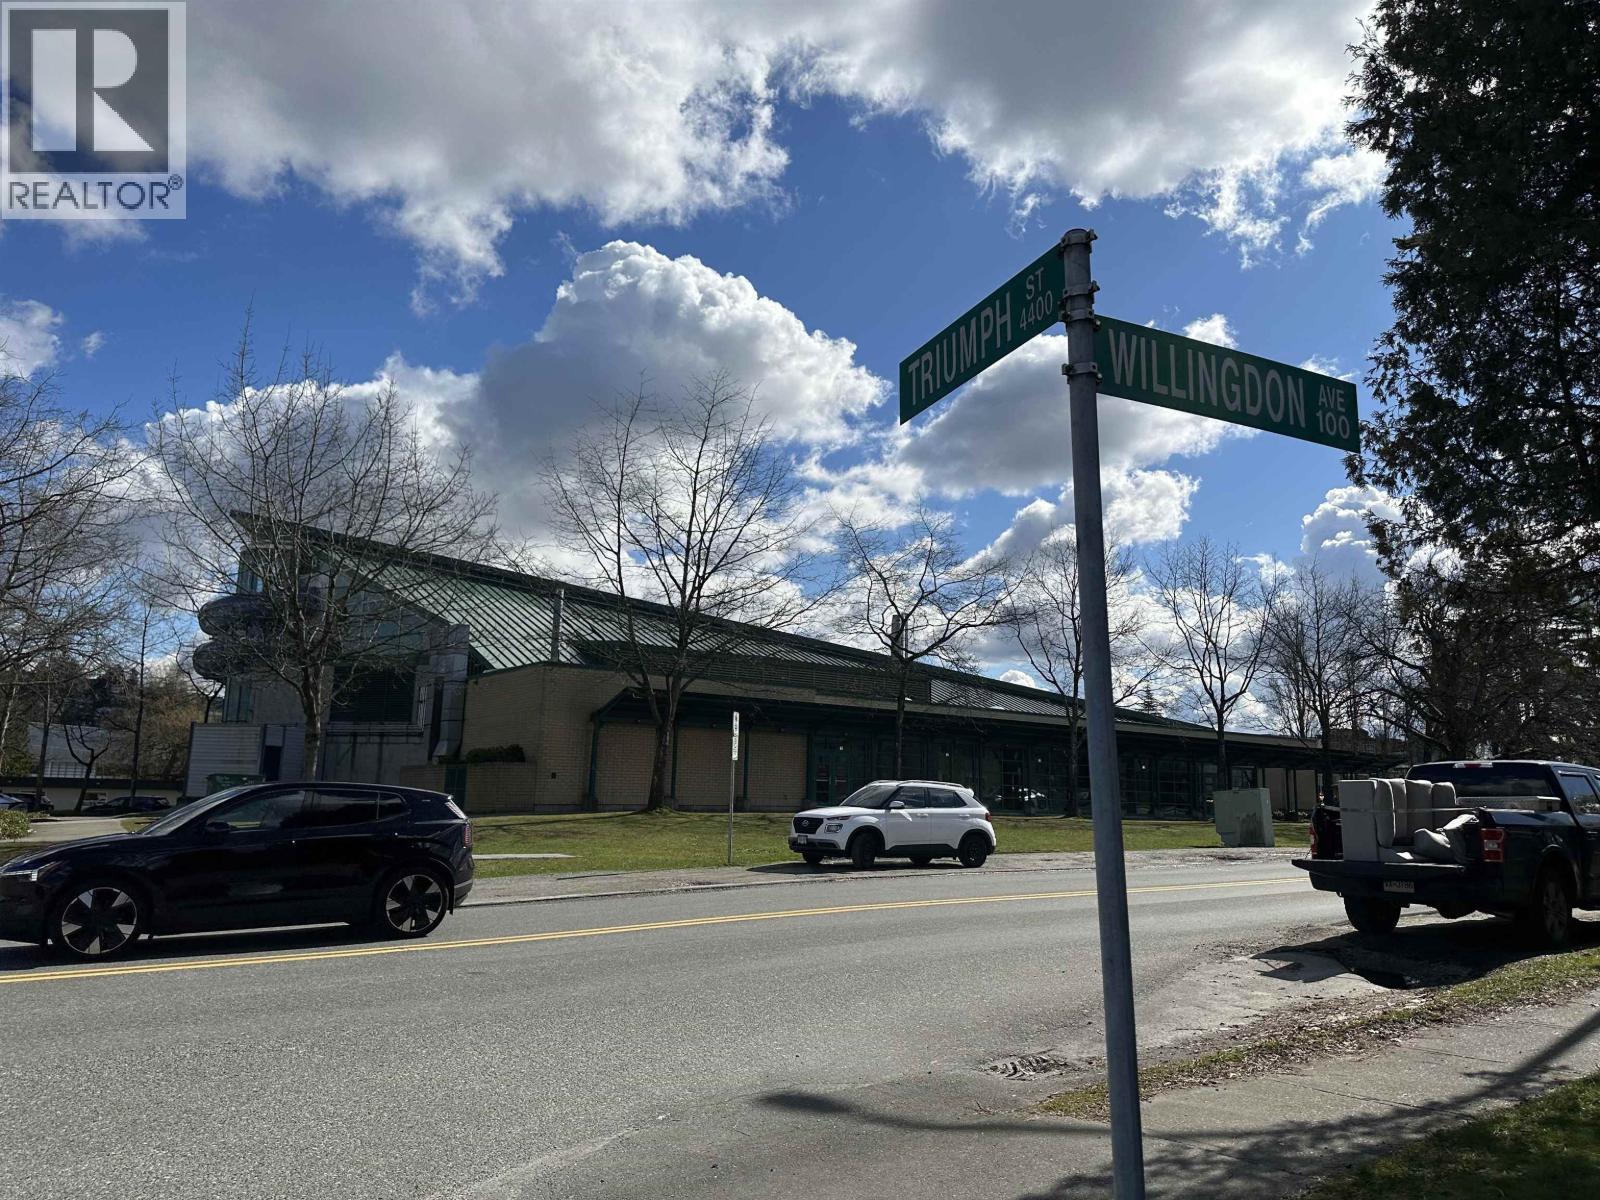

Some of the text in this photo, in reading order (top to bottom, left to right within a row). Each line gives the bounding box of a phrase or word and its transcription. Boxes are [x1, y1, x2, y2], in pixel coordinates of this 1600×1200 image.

[908, 267, 1044, 405] TRIUMPH ST
[1019, 290, 1053, 330] 4400
[1108, 328, 1346, 428] WILLINGDON AVE
[1315, 411, 1350, 440] 100
